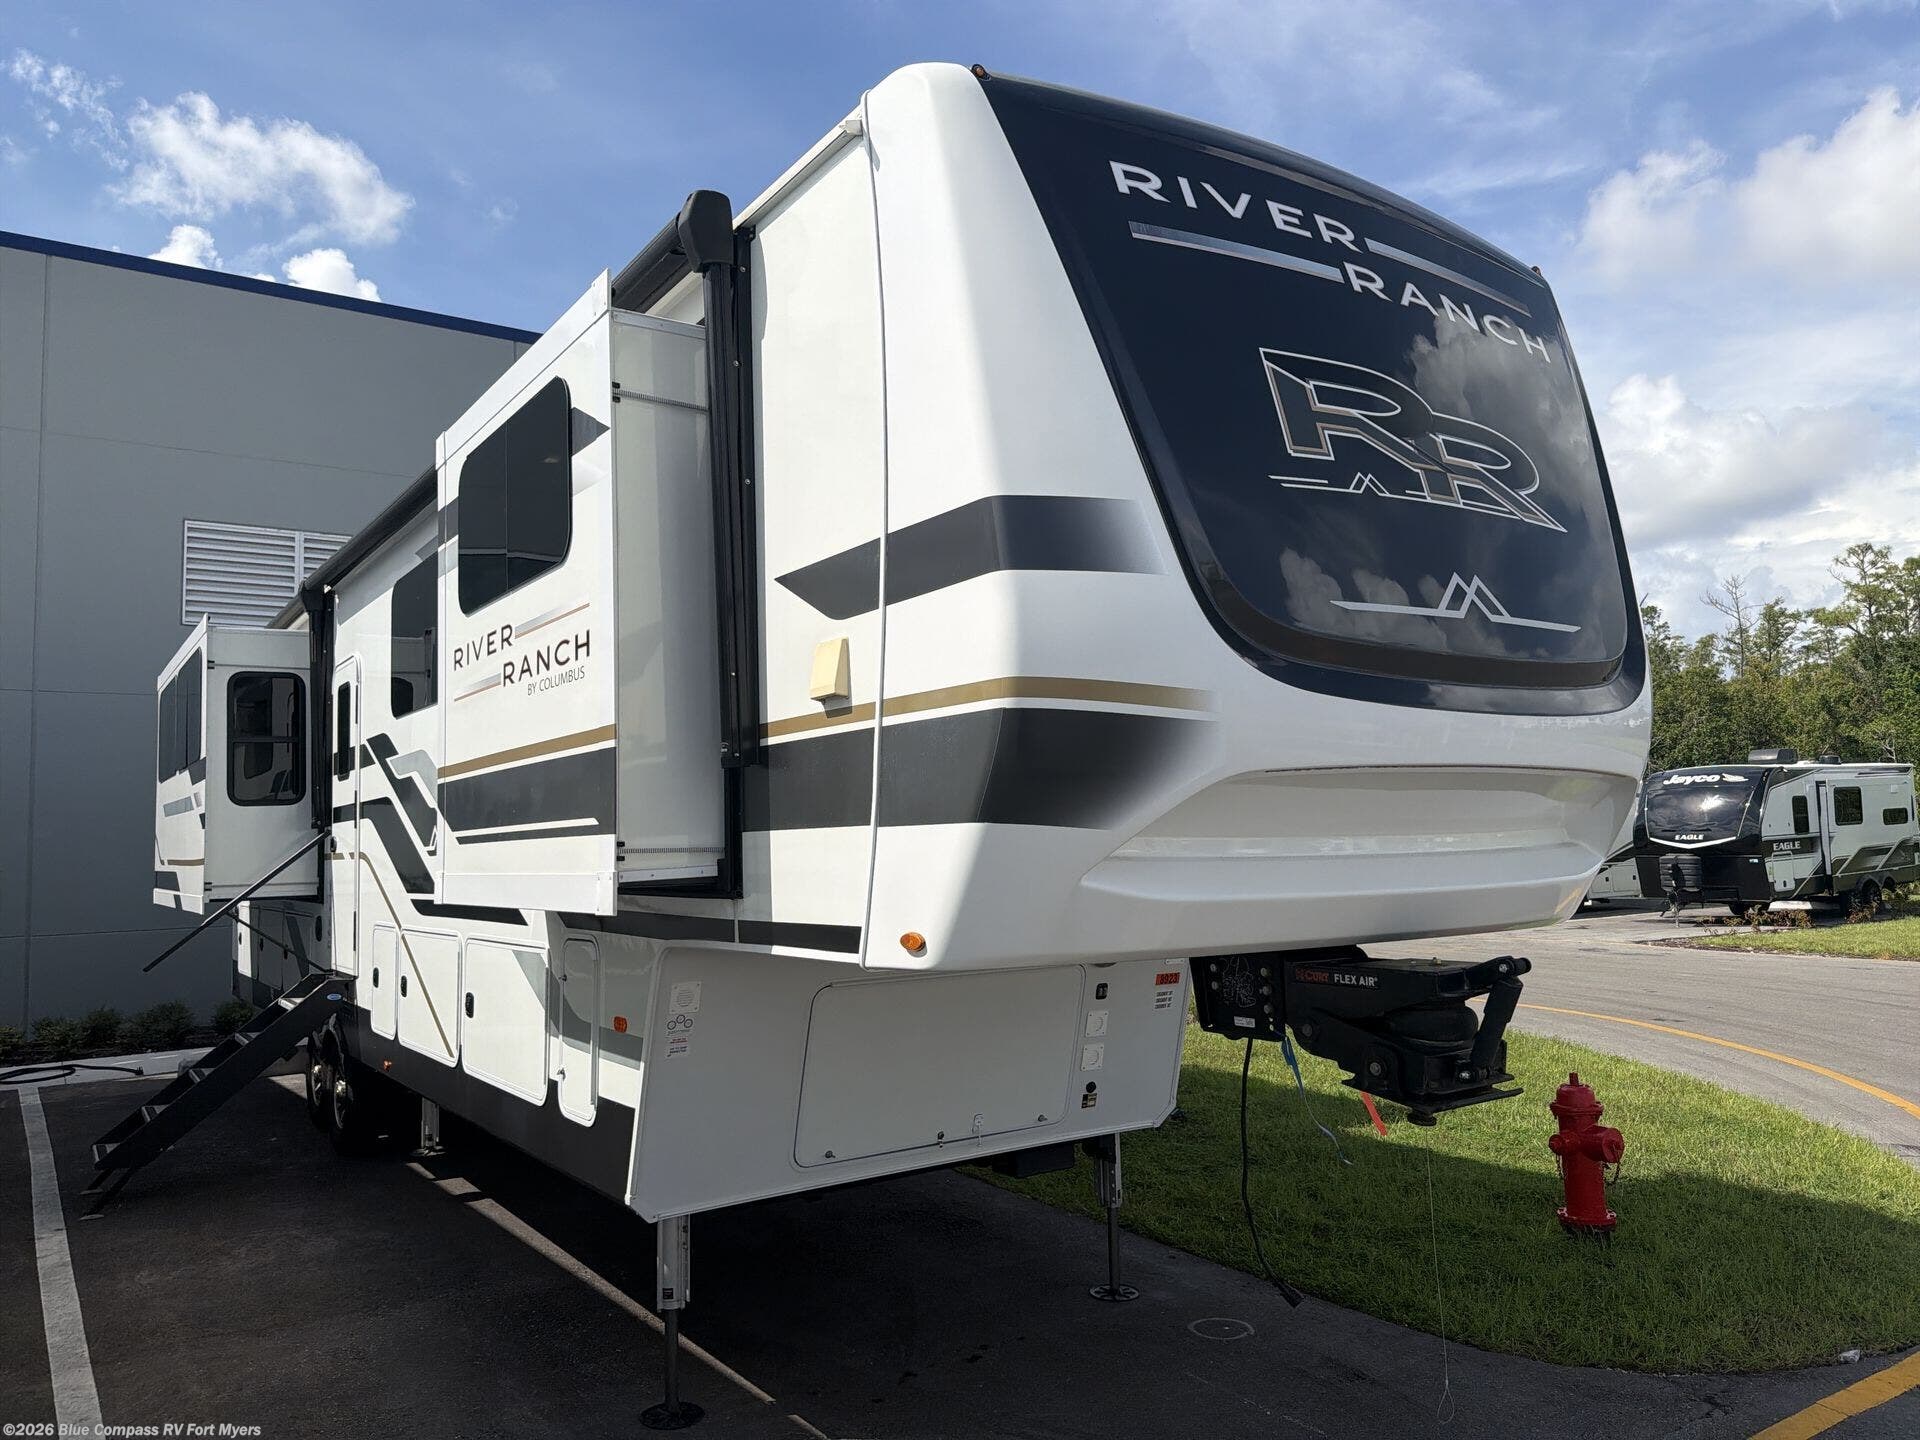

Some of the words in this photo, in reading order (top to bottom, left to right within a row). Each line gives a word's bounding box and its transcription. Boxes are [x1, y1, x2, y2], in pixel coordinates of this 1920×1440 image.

[1109, 160, 1364, 253] RIVER
[1342, 261, 1551, 363] RANCH
[454, 624, 513, 671] RIVER
[503, 630, 590, 687] RANCH
[527, 682, 537, 696] BY
[539, 665, 585, 692] COLUMBUS
[1663, 774, 1721, 785] Jayco
[1772, 840, 1802, 851] EAGLE
[1333, 973, 1357, 985] FLEX
